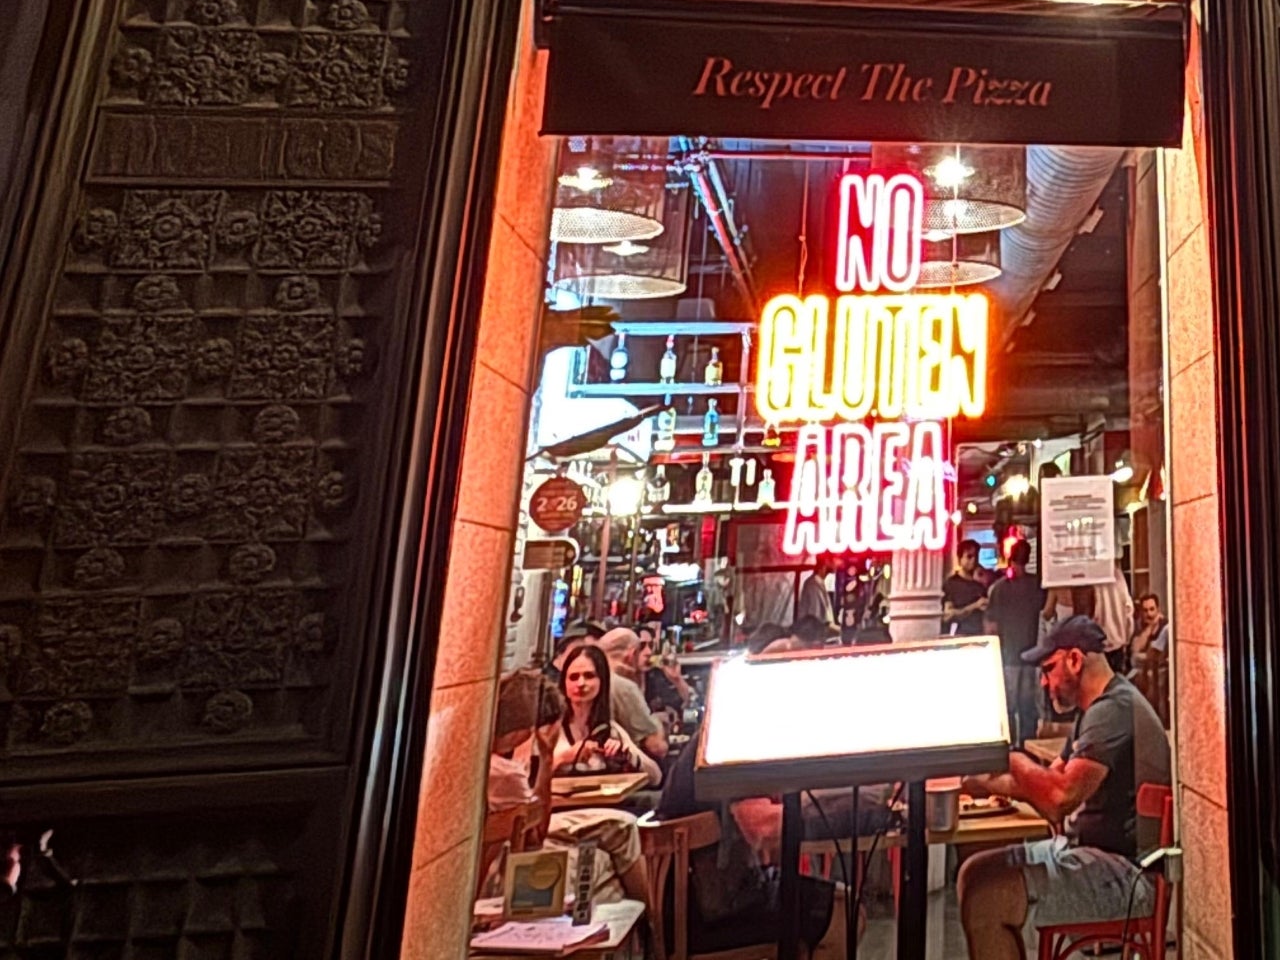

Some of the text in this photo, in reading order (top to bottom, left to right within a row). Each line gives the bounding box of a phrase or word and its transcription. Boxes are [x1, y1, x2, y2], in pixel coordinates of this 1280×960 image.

[693, 56, 1053, 110] Respect The Pizza
[836, 173, 924, 292] NO
[755, 293, 988, 422] GLUTEN
[783, 420, 948, 555] AREA
